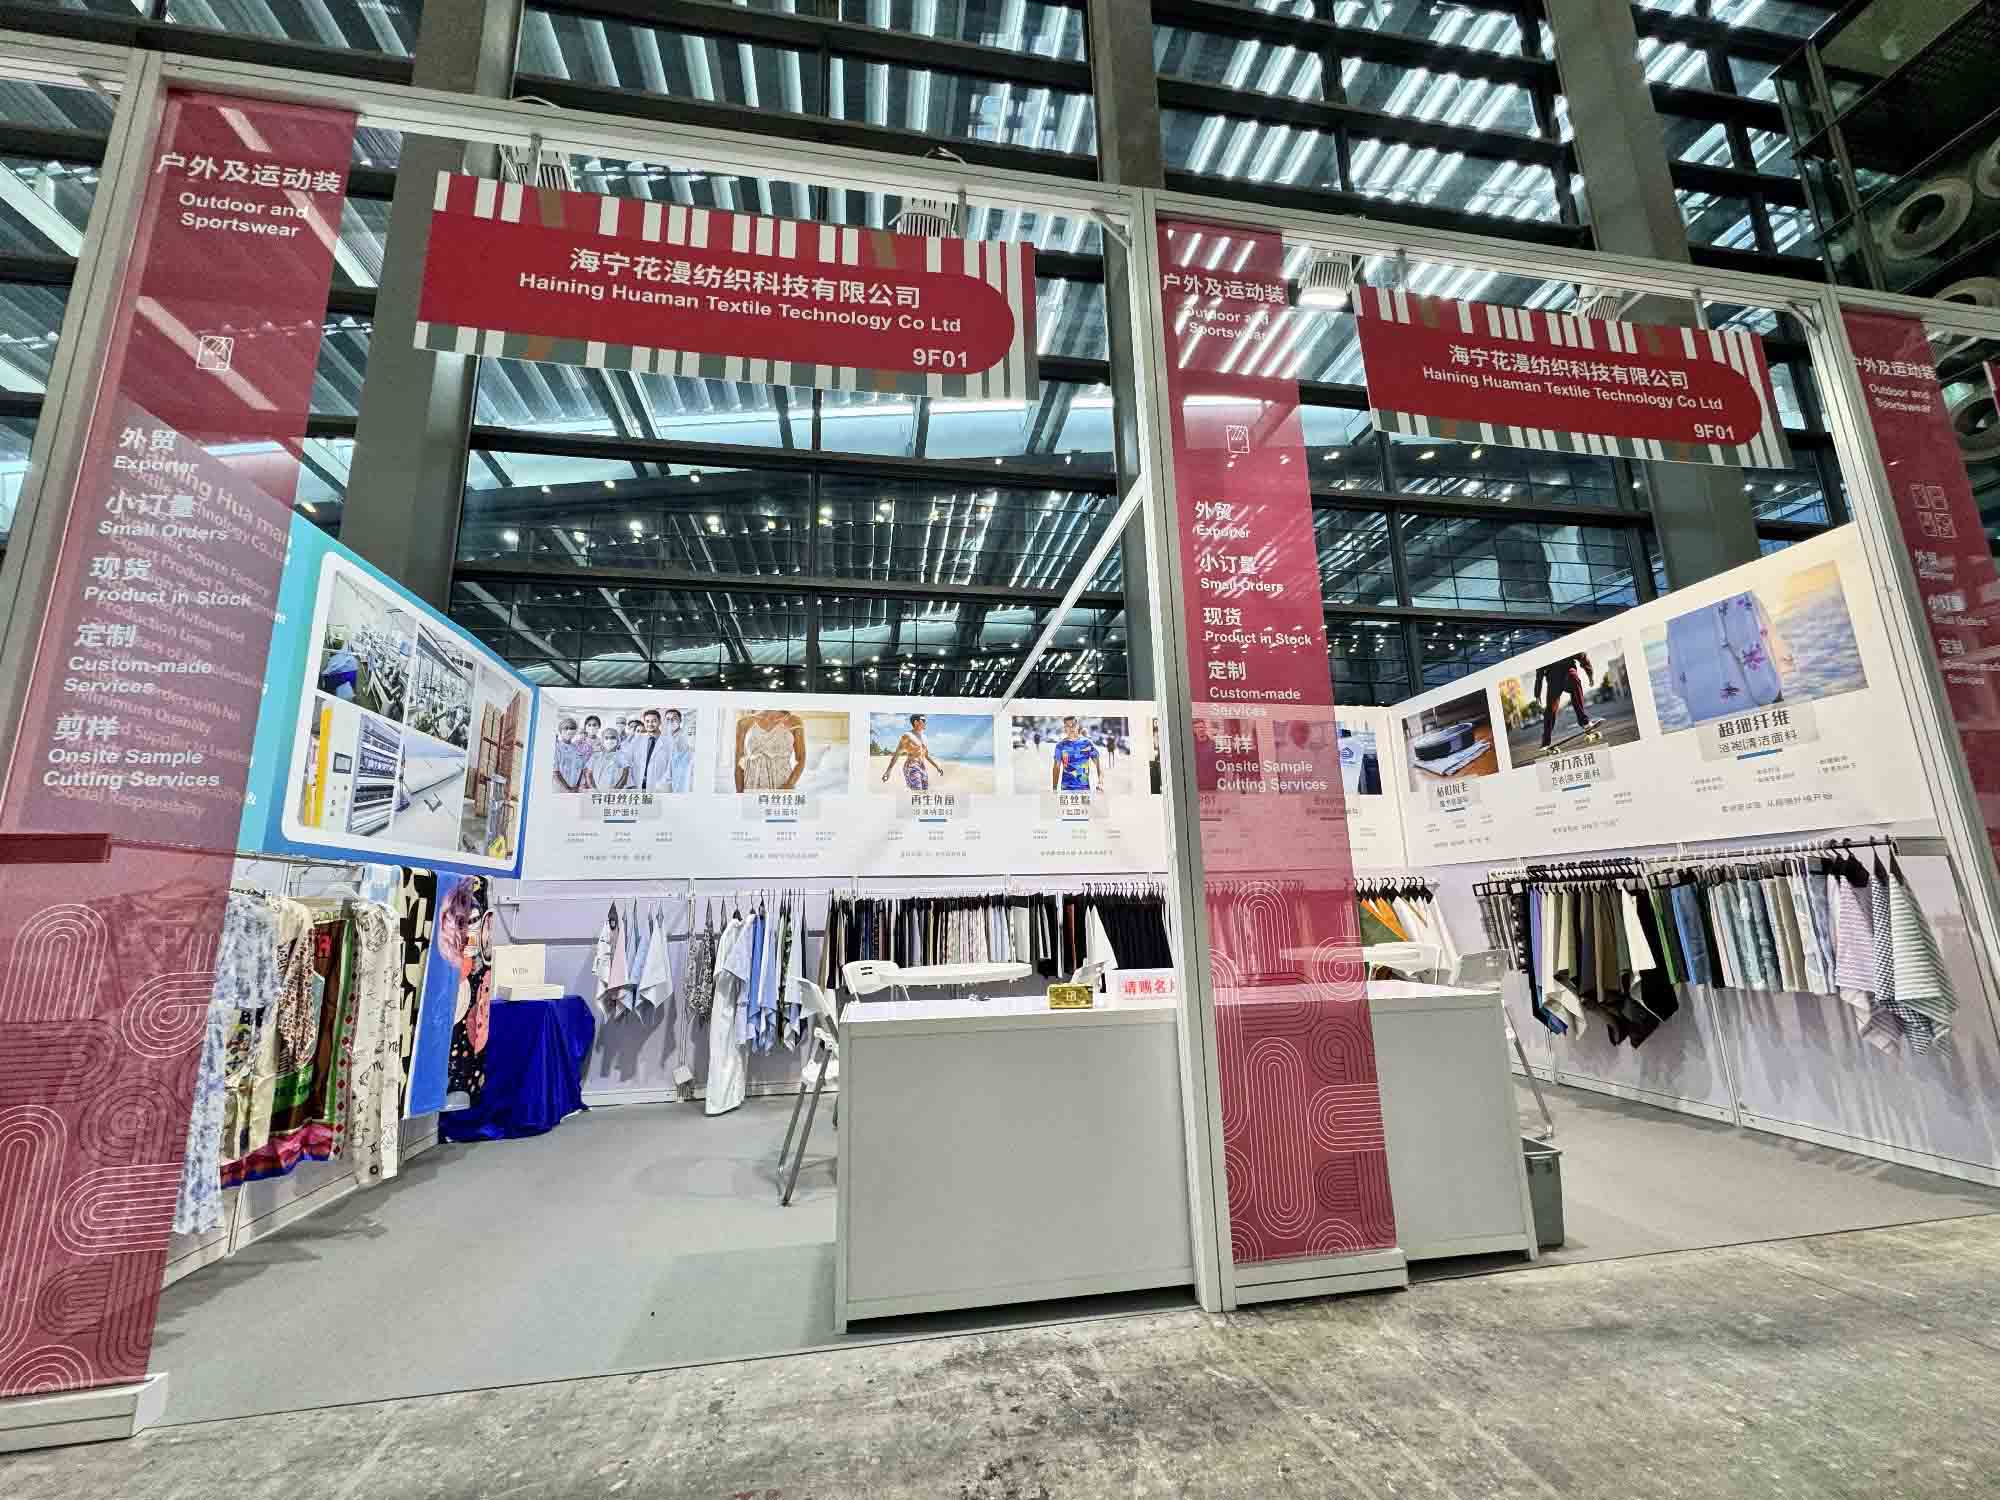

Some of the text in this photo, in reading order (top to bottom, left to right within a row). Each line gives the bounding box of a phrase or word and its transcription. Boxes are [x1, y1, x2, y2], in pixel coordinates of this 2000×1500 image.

[156, 152, 341, 193] 户外及运动装
[179, 192, 308, 219] Outdoor and
[181, 212, 300, 238] Sportswear
[569, 247, 920, 310] 海宁花漫纺织科技有限公司
[1162, 274, 1285, 305] 户外及运动装
[519, 272, 961, 333] Haining Huaman Textile Technology Co Ltd
[1184, 306, 1240, 322] Outdoor
[1189, 322, 1266, 340] Sportswear
[912, 349, 968, 369] 9F01
[1449, 344, 1688, 390] 海宁花漫纺织科技有限公司
[1423, 367, 1723, 411] Haining Huaman Textile Technology Co Ltd
[120, 428, 177, 450] 外贸
[1694, 424, 1734, 440] 9F01
[1195, 501, 1232, 521] 外贸
[98, 520, 228, 541] Small Orders
[89, 557, 152, 580] 现货
[1200, 553, 1258, 575] 小订量
[84, 586, 252, 607] Product in Stock
[1203, 607, 1242, 626] 现货
[75, 623, 137, 648] 定制
[1205, 631, 1312, 645] Product in Stock
[69, 656, 212, 674] Custom-made
[1208, 660, 1247, 681] 定制
[63, 678, 154, 695] Services
[1210, 687, 1301, 700] Custom-made
[54, 713, 120, 741] 剪样
[1719, 710, 1790, 738] 超细纤维
[1215, 734, 1254, 754] 剪样
[48, 749, 204, 768] Onsite Sample
[1215, 760, 1313, 774] Onsite Sample
[43, 770, 220, 790] Cutting Services
[1217, 778, 1328, 793] Cutting Services
